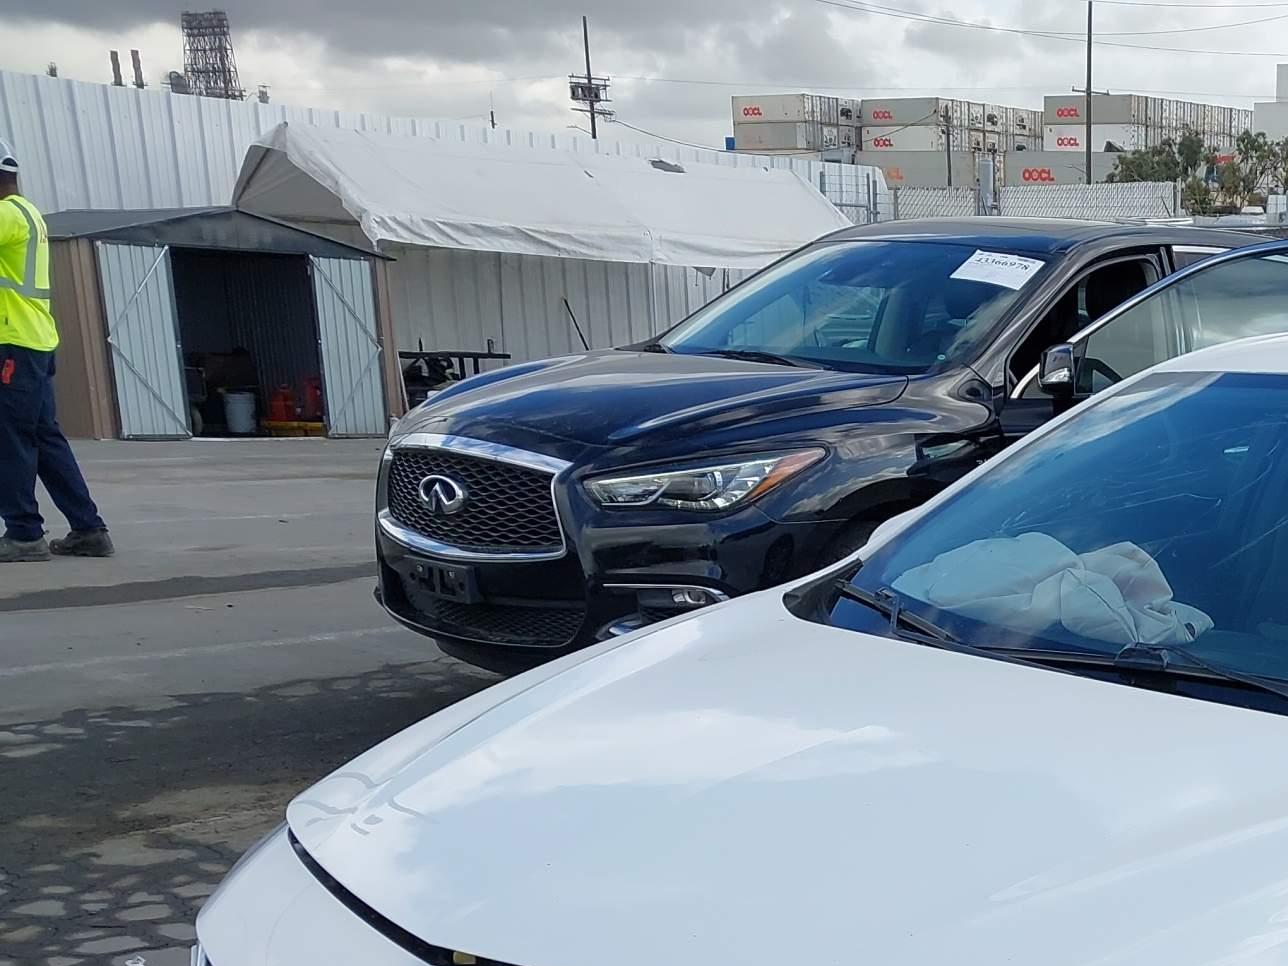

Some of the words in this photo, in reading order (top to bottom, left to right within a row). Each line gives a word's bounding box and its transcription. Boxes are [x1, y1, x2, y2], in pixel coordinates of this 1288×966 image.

[743, 107, 762, 116] OOCL
[873, 110, 892, 120] OOCL
[1056, 108, 1080, 117] OOCL
[874, 138, 893, 147] OOCL
[1057, 137, 1080, 146] OOCL
[1022, 169, 1054, 181] OOCL
